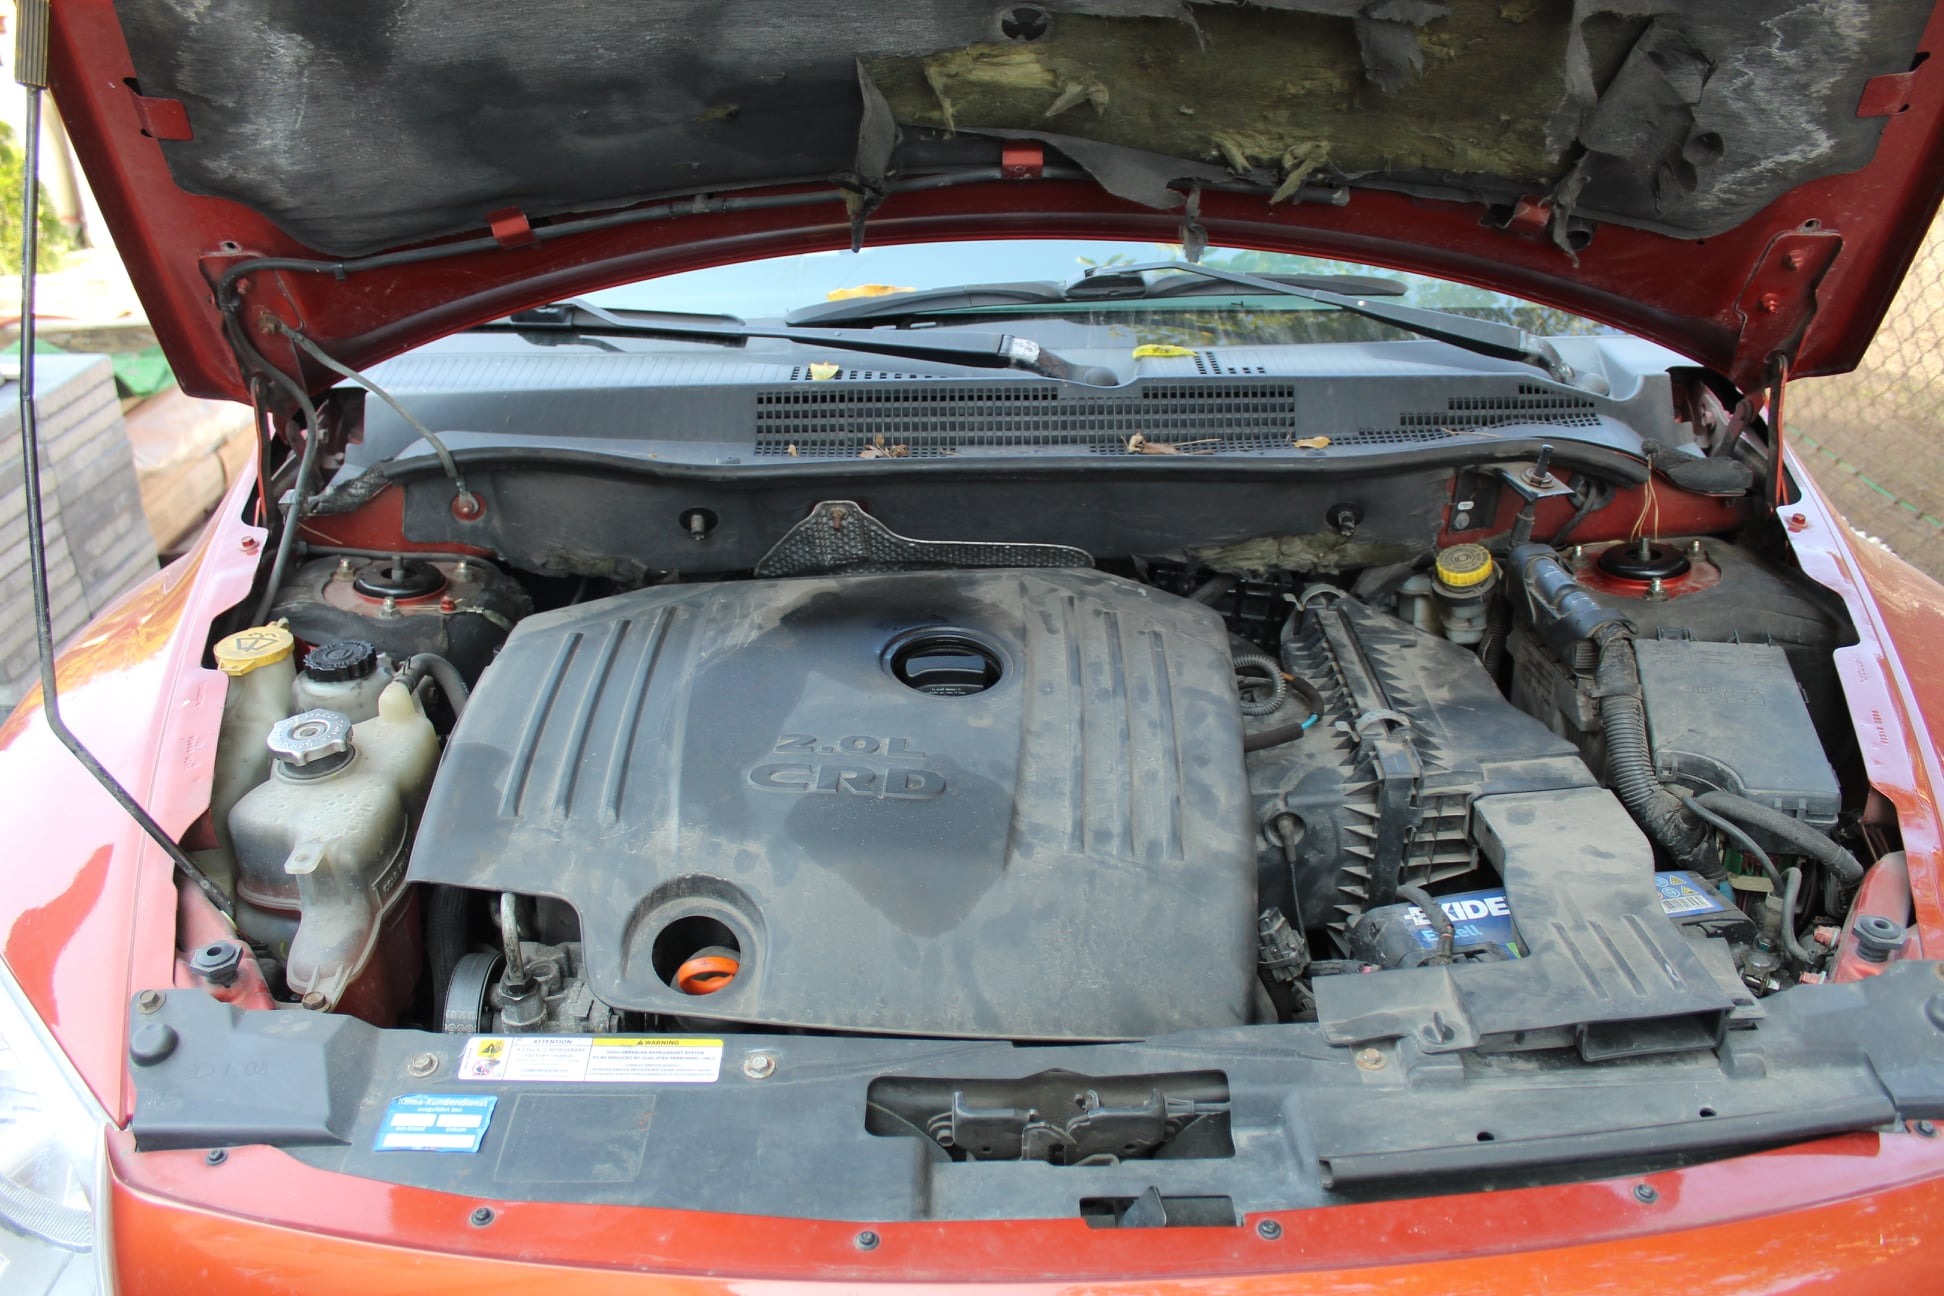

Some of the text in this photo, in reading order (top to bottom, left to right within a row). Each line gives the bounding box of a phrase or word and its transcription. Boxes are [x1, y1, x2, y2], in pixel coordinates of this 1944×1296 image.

[773, 733, 926, 759] 2.0L
[748, 763, 947, 799] CRD
[1421, 925, 1483, 942] Eell
